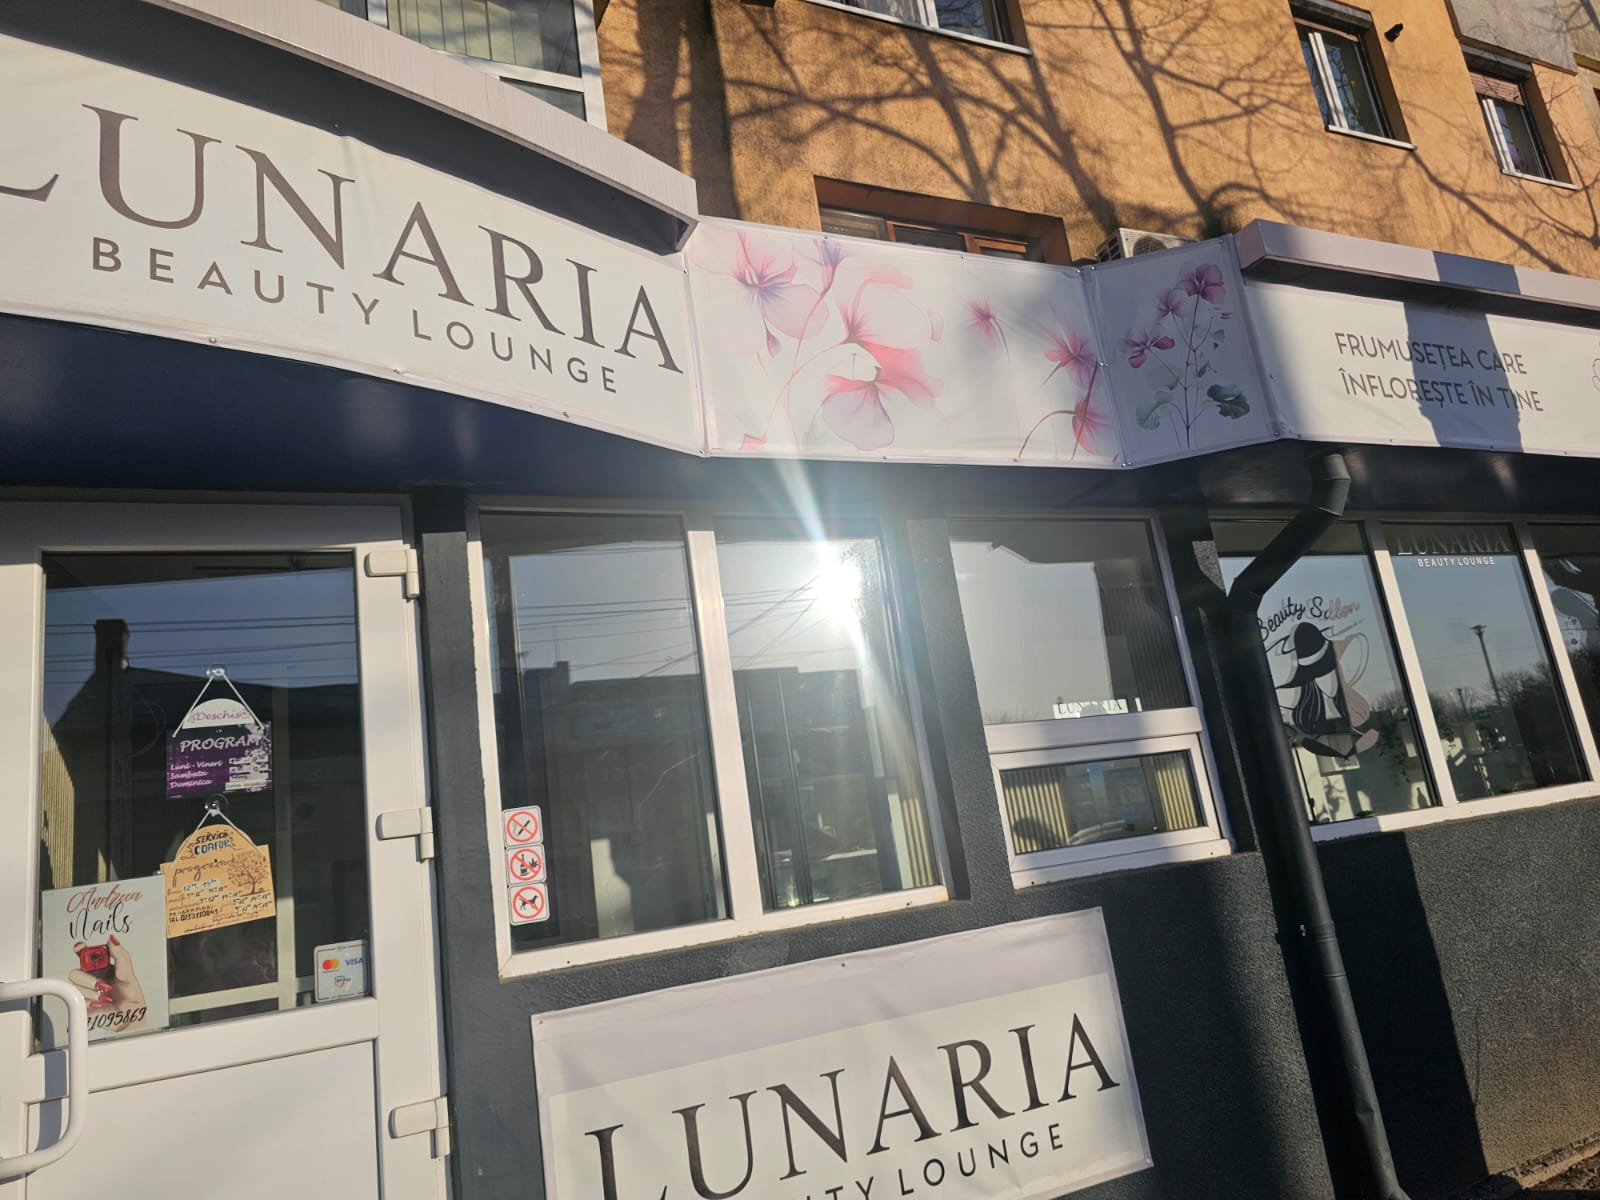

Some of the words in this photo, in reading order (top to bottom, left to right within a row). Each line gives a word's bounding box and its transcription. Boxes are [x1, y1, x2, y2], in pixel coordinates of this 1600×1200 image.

[92, 236, 380, 325] BEAUTY
[412, 309, 617, 394] LOUNGE
[1334, 332, 1474, 371] FRUMUSEȚEA
[1476, 349, 1528, 375] CARE
[1338, 367, 1469, 408] ÎNFLOREȘTE
[1467, 380, 1496, 407] ÎN
[1497, 387, 1544, 411] TINE
[1396, 526, 1512, 555] LUNARIA
[1417, 557, 1456, 567] BEAUTY
[1456, 556, 1496, 566] LOUNGE
[180, 735, 260, 753] PROGRAM
[69, 902, 134, 941] Nails
[345, 957, 367, 966] VISA
[67, 1006, 147, 1034] 1095869
[584, 1013, 1120, 1200] LUNARIA
[898, 1122, 1064, 1196] LOUNGE
